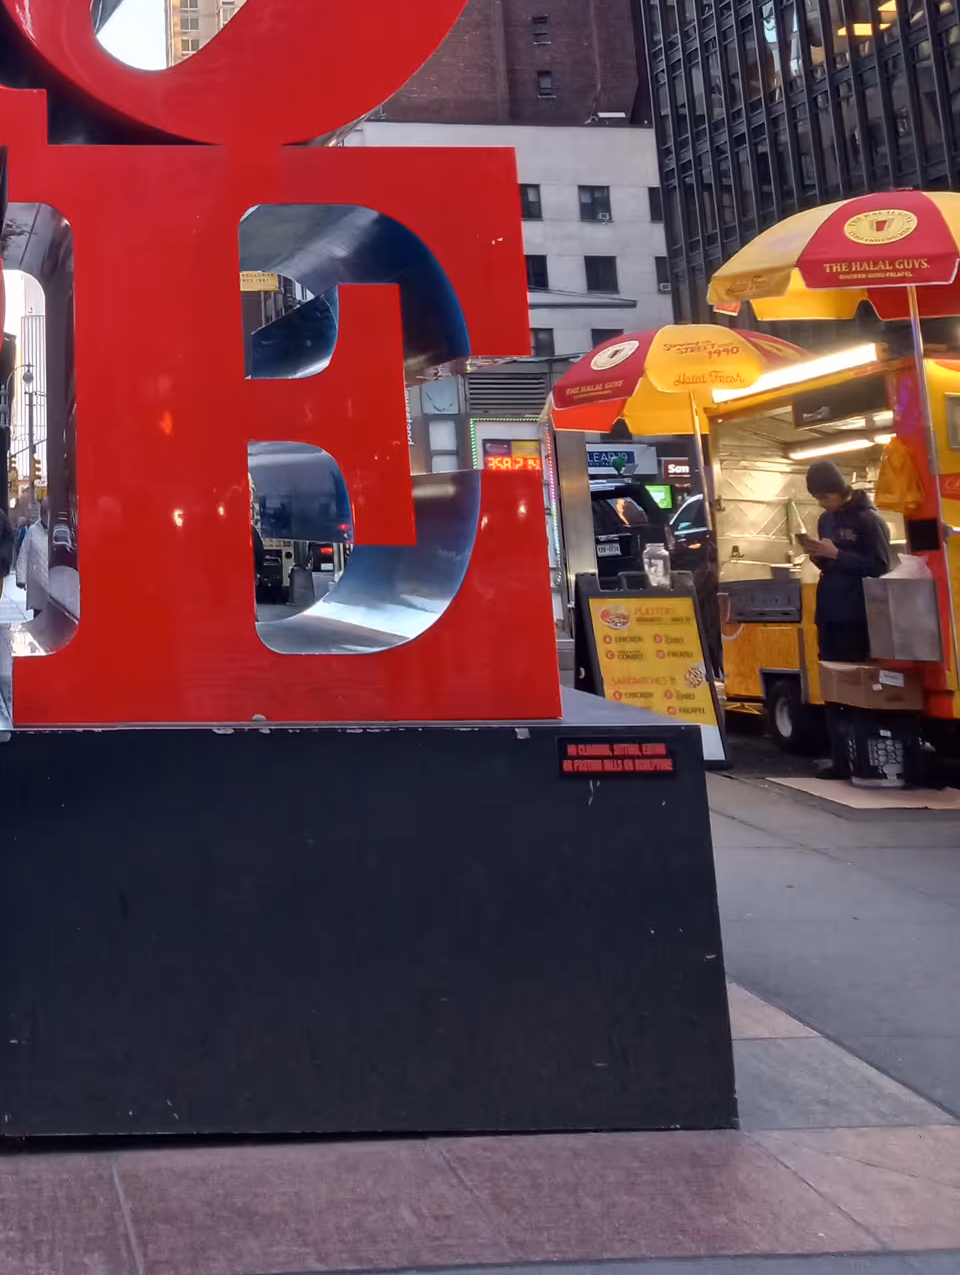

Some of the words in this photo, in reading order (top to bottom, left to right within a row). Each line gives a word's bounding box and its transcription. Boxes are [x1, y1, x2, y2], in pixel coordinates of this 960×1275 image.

[823, 263, 849, 273] THE
[851, 260, 893, 272] HALAL
[708, 345, 740, 359] 1990
